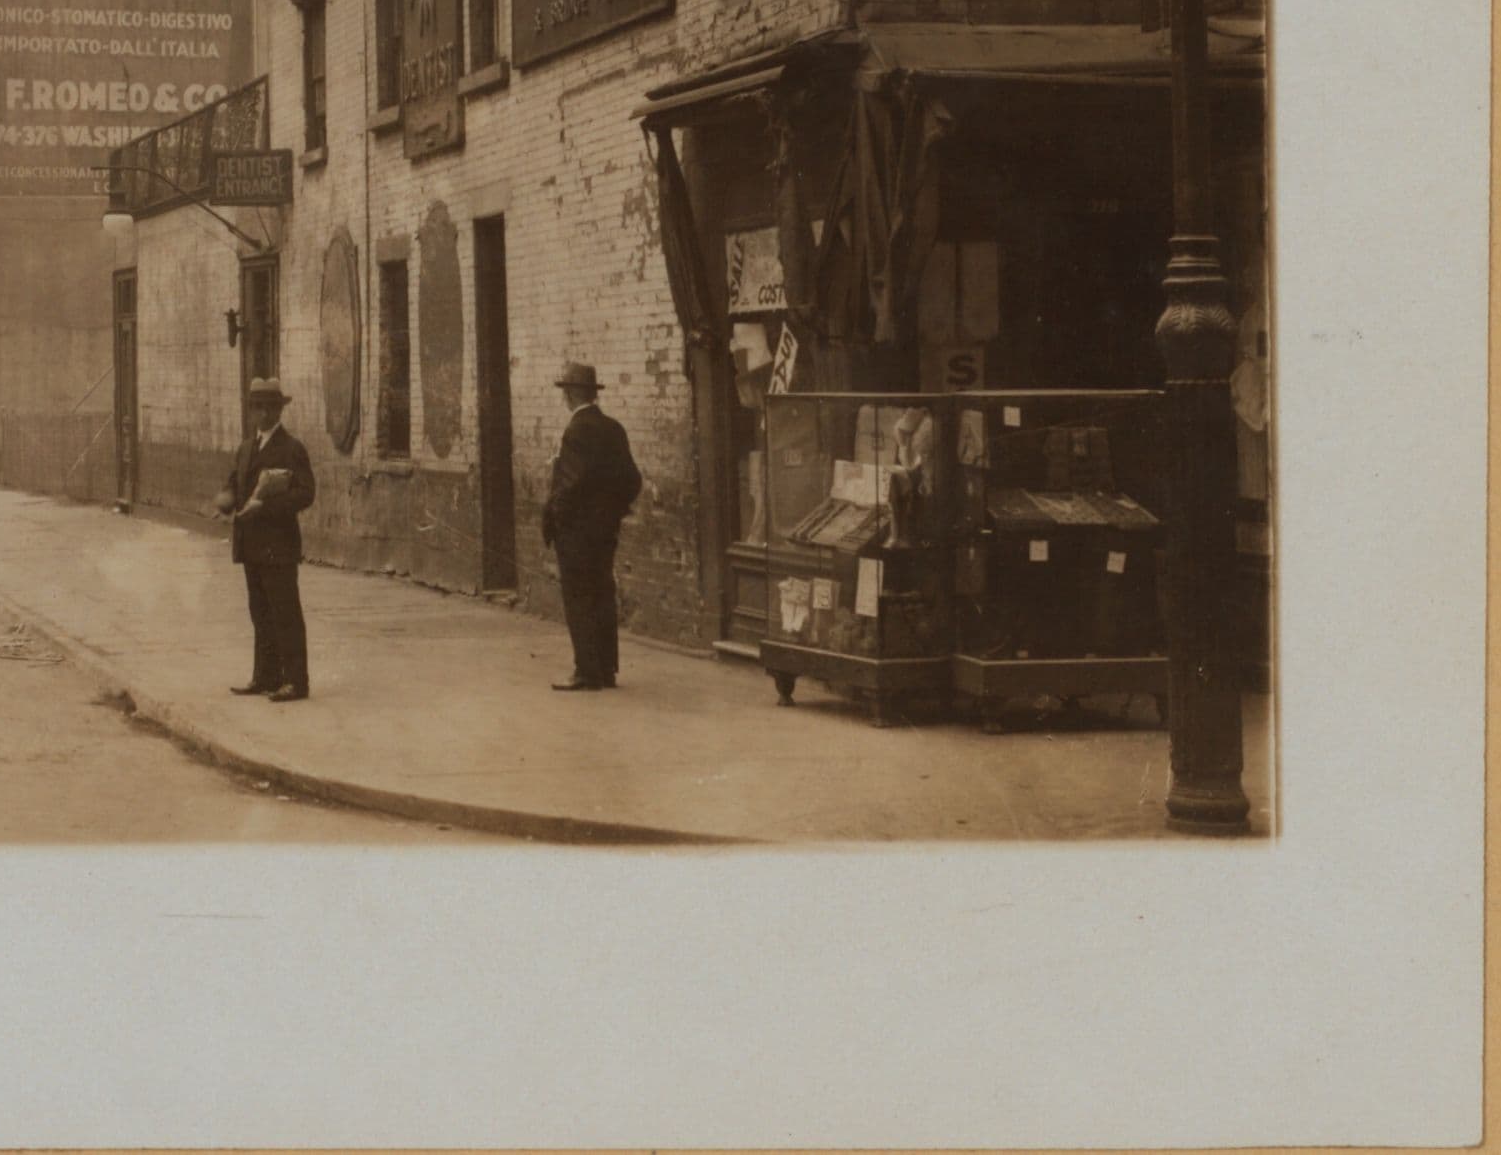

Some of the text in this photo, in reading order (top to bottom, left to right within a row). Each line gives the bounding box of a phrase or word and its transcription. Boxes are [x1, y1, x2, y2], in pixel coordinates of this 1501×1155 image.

[153, 82, 178, 113] &
[217, 157, 284, 178] DENTIST
[216, 176, 284, 198] ENTRANCE
